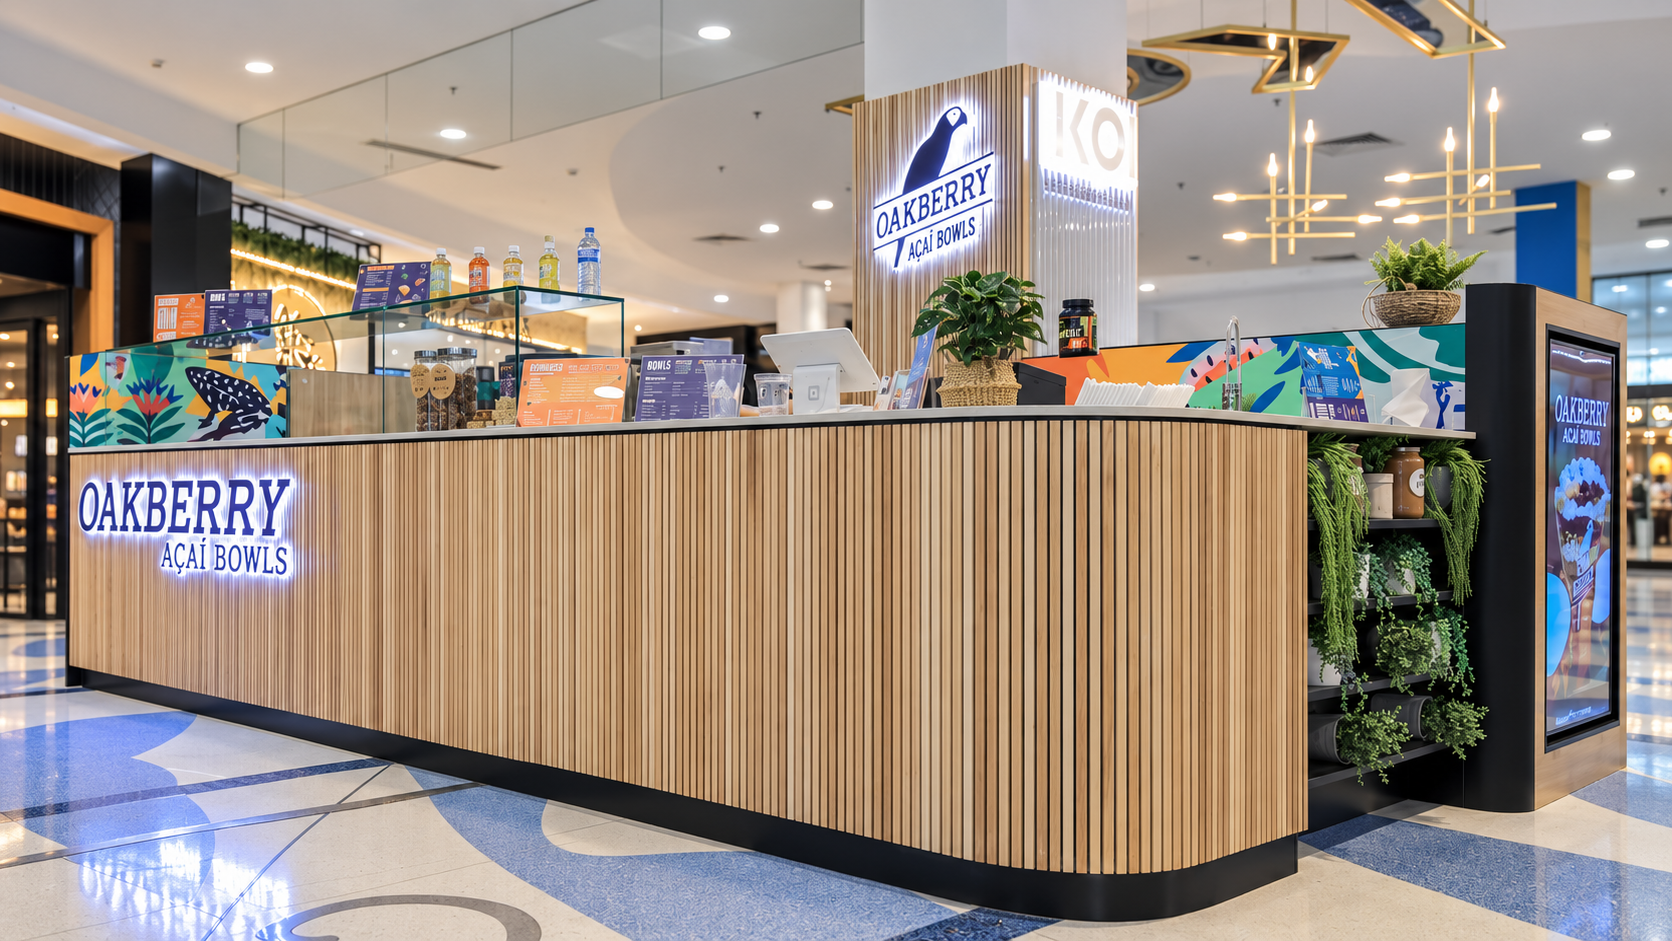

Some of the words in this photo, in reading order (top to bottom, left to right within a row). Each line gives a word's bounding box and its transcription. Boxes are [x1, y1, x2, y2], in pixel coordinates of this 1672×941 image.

[876, 163, 992, 239] OAKBERRY
[908, 229, 933, 262] AÇAÍ
[936, 216, 976, 248] BOWLS
[1555, 394, 1609, 427] OAKBERRY
[1580, 428, 1601, 446] BOWLS
[78, 478, 291, 537] OAKBERRY
[161, 537, 207, 575] AÇAÍ
[213, 544, 288, 576] BOWLS
